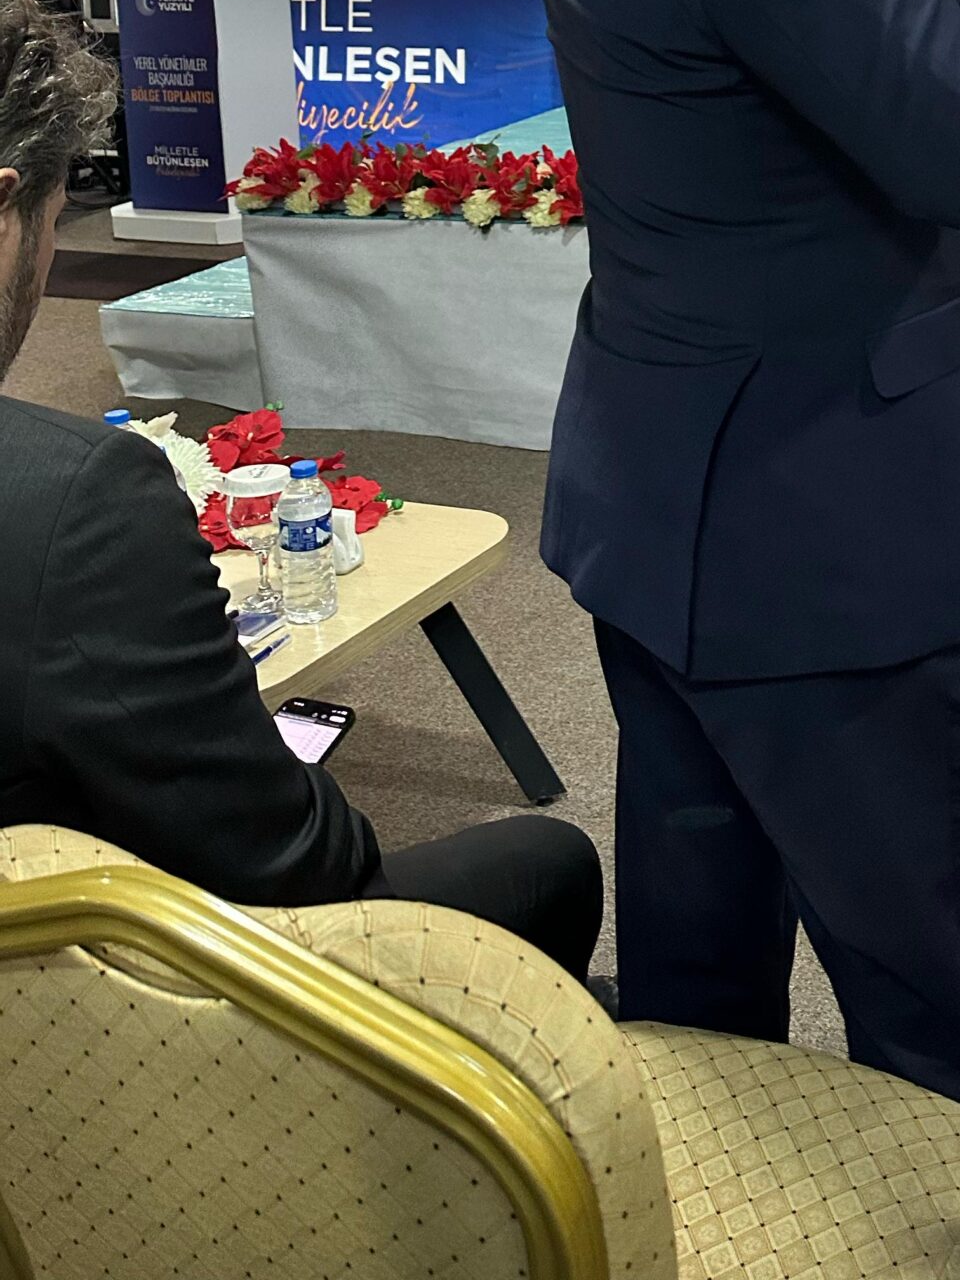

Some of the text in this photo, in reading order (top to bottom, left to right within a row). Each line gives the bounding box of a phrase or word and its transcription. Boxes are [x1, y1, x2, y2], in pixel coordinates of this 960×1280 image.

[133, 54, 208, 72] YEREL YÖNETİMLER
[148, 71, 195, 88] BAŞKANLIĞI
[131, 86, 215, 105] BÖLGE TOPLANTISI
